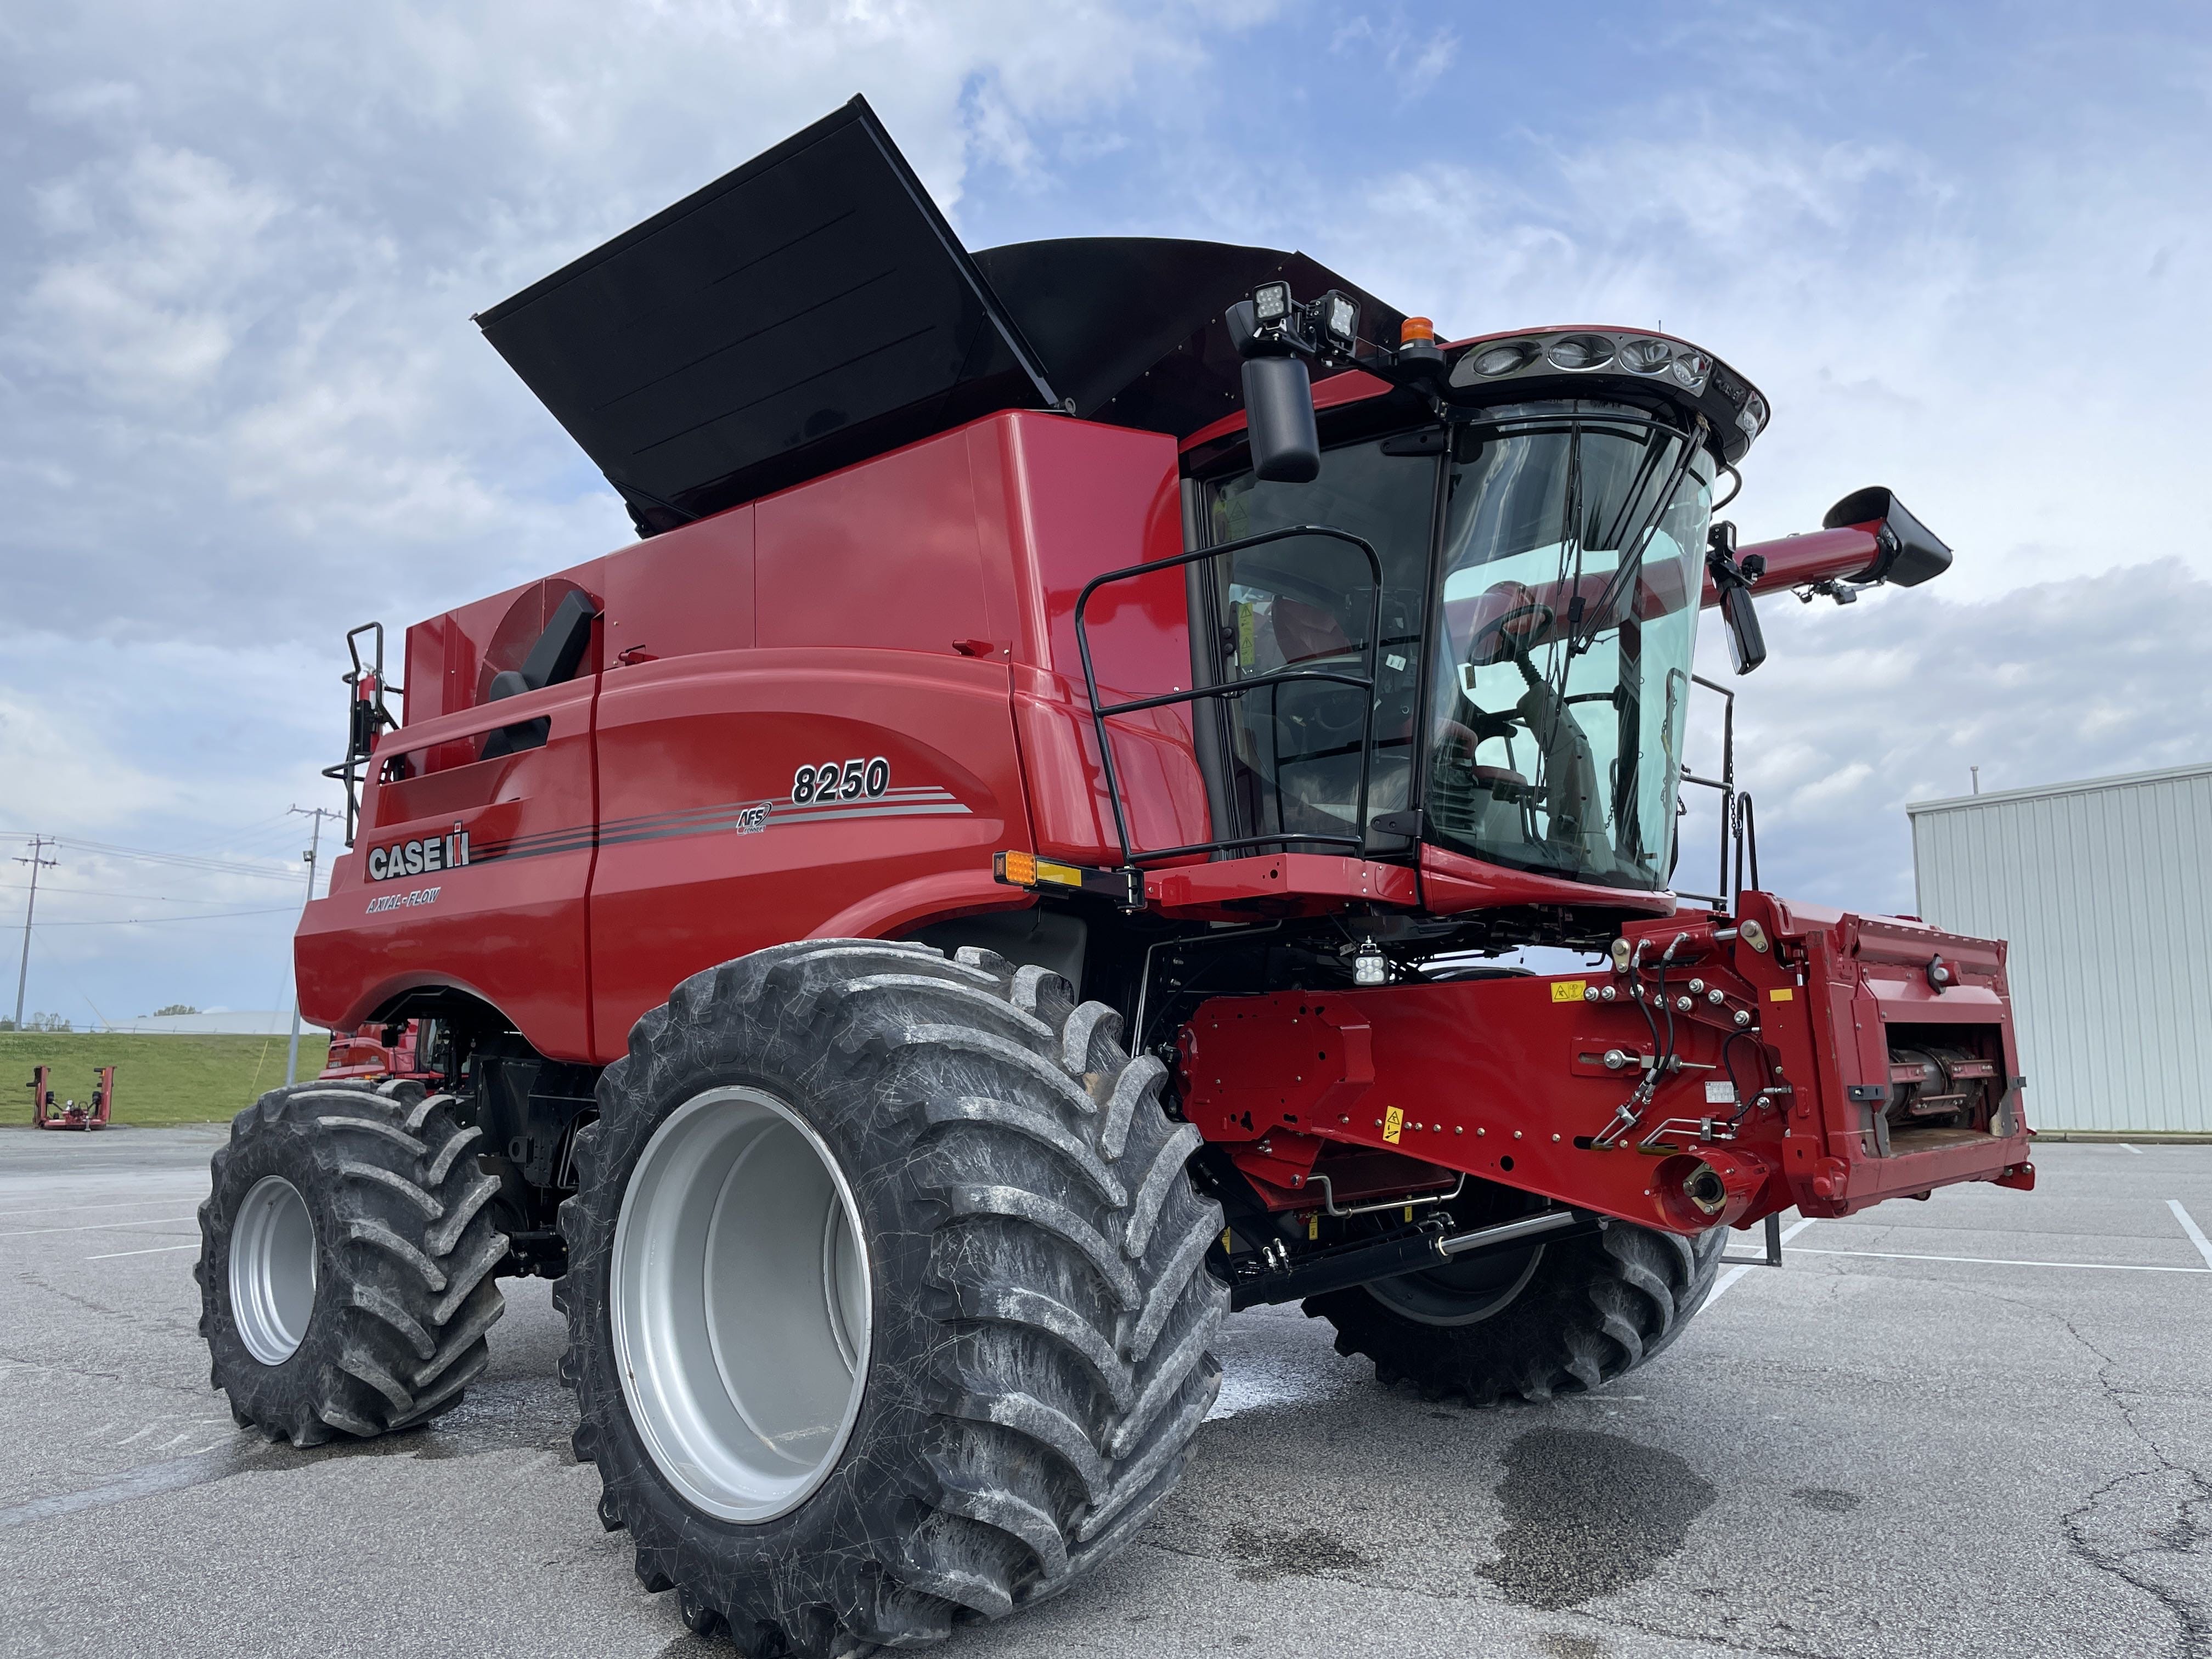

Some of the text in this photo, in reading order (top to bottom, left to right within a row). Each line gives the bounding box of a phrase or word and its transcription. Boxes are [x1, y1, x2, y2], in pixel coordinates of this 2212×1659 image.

[792, 757, 889, 805] 8250
[736, 806, 765, 827] AFS
[369, 836, 441, 880] CASE
[365, 887, 441, 914] AXIAL-FLOW
